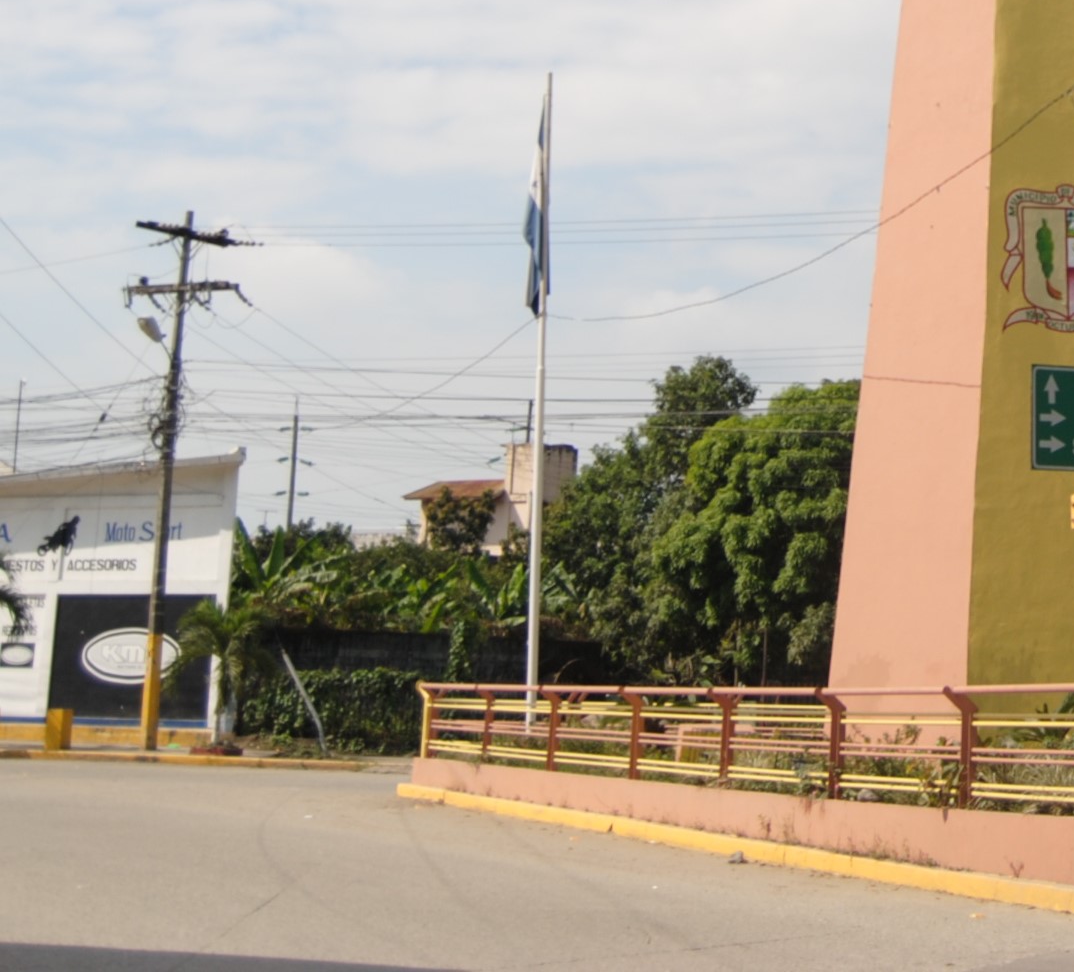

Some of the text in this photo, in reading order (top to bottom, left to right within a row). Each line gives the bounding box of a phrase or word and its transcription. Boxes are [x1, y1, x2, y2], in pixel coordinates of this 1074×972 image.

[1008, 191, 1058, 217] MUNICIPIO
[104, 522, 136, 542] Moto
[51, 559, 59, 571] Y
[67, 559, 137, 572] ACCESORIOS
